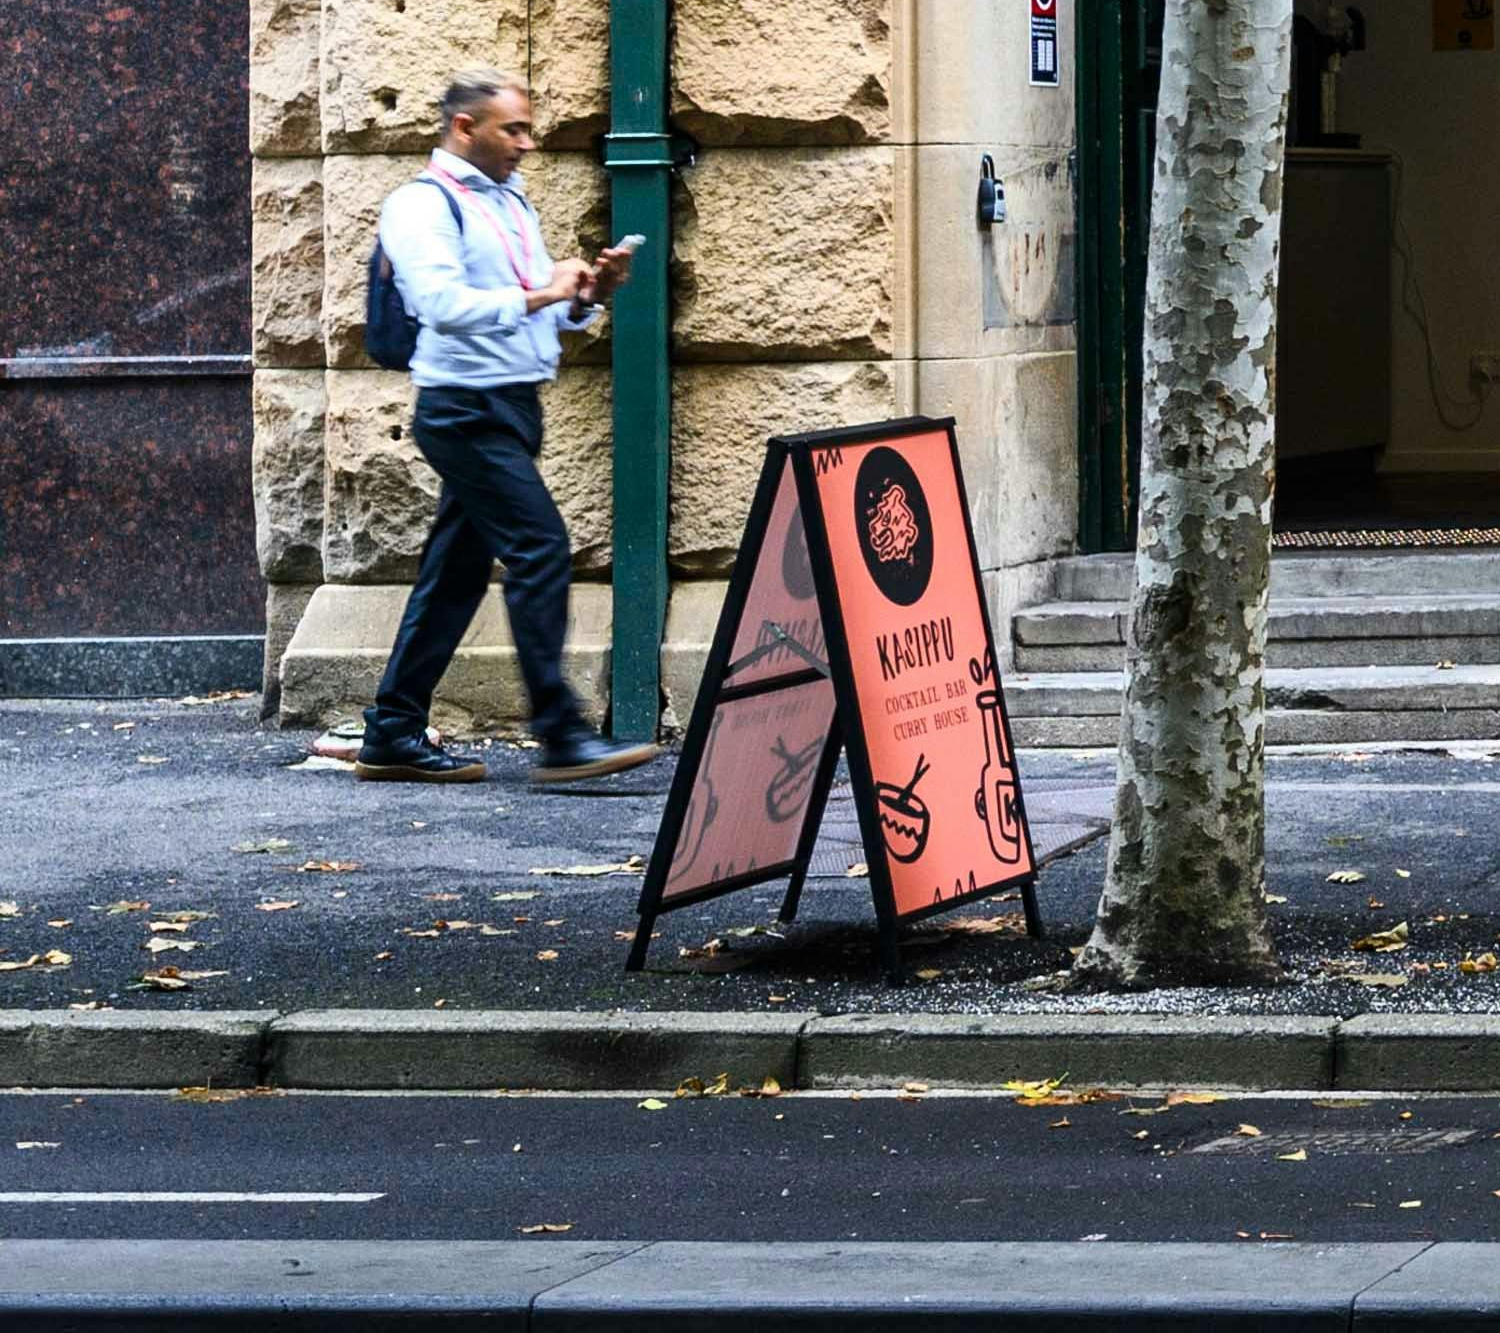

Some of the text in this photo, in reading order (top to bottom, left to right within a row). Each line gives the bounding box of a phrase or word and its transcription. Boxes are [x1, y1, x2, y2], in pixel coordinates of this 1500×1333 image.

[876, 616, 954, 682] KASIPPU
[885, 678, 968, 715] COCKTAIL BAR
[893, 706, 969, 742] CURRY HOUSE
